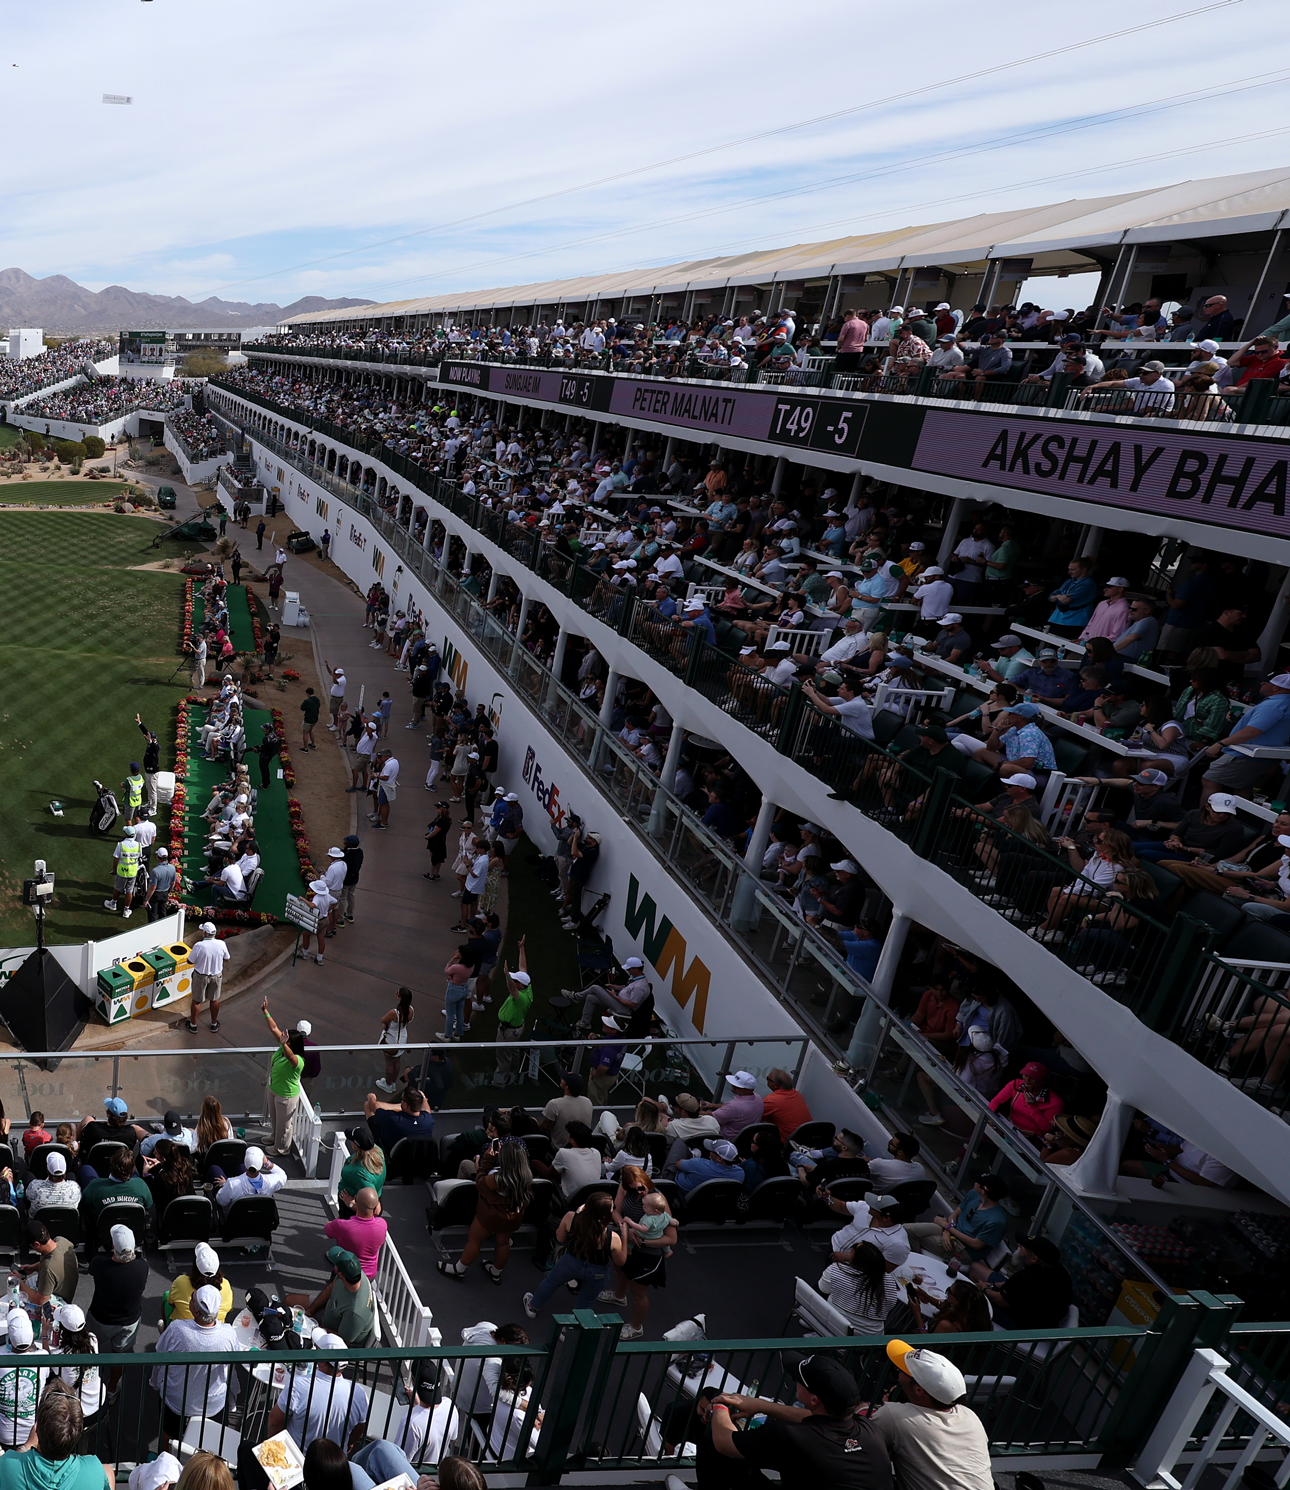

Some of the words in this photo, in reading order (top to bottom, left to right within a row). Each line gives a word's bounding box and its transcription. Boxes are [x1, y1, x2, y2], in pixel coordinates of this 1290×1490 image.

[449, 367, 462, 380] NOW
[462, 368, 481, 384] PLAYING
[505, 373, 531, 392] SUNGJAE
[531, 376, 541, 394] IM
[561, 379, 576, 400] T49
[579, 381, 590, 402] -5
[631, 386, 669, 417] PETER
[671, 390, 736, 426] MALNATI
[776, 403, 813, 439] T49
[826, 411, 854, 445] -5
[981, 429, 1166, 493] AKSHAY
[1165, 449, 1289, 517] BHA
[316, 496, 328, 522] WM
[353, 528, 364, 550] FedEx
[372, 544, 385, 581] WM
[441, 635, 469, 692] WM
[531, 762, 566, 830] FedEx
[624, 872, 711, 1036] WM
[156, 978, 173, 987] WM
[113, 995, 131, 1005] WM
[102, 1196, 116, 1205] BAD
[117, 1195, 139, 1203] BIRDIE
